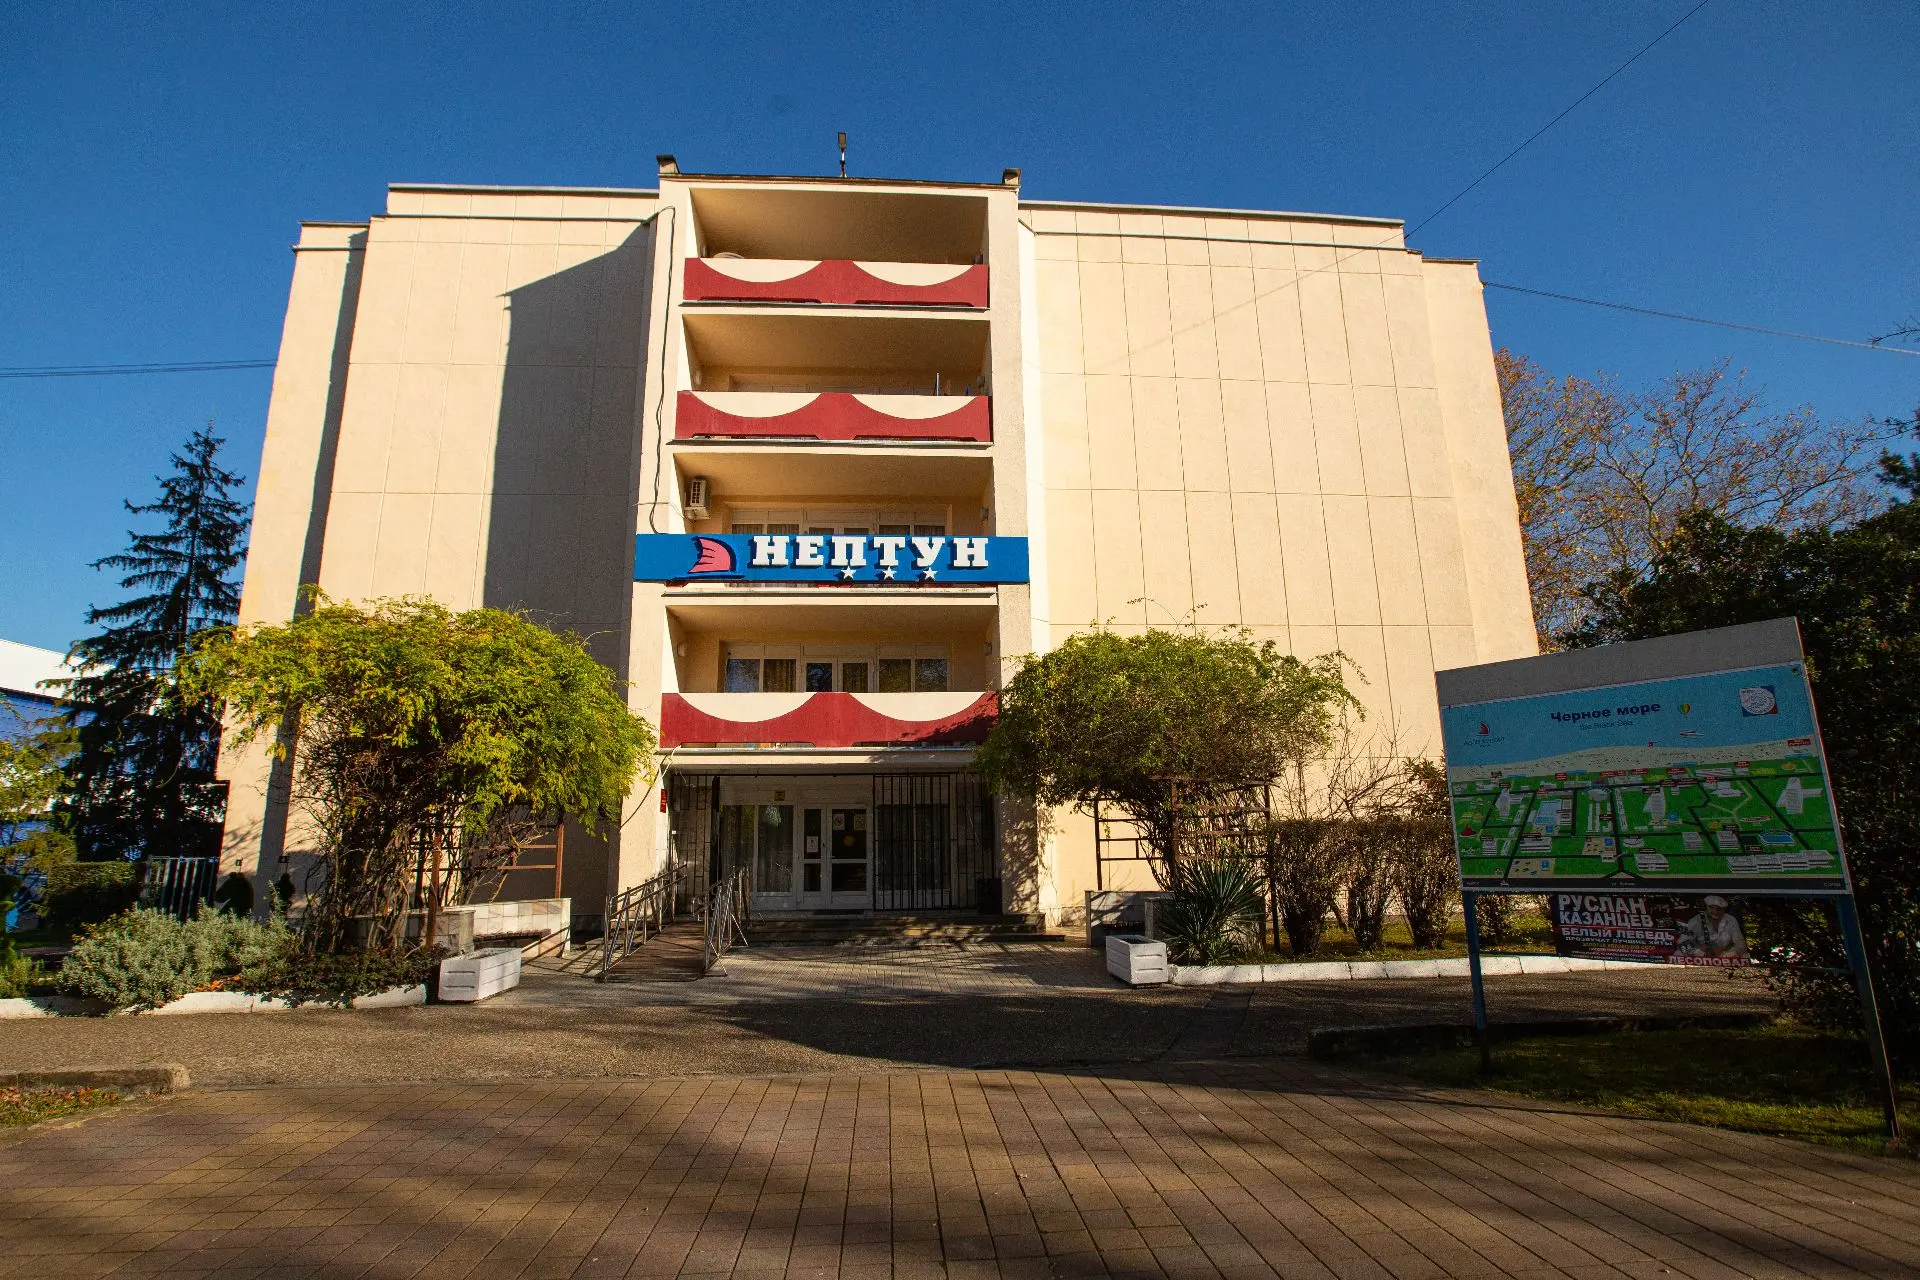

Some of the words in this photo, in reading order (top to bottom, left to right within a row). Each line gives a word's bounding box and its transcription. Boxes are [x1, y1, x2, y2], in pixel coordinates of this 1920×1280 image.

[752, 535, 989, 568] НЕПТУН
[1550, 707, 1612, 724] Черное
[1617, 702, 1661, 716] море
[1557, 894, 1647, 915] РУСЛАН
[1559, 911, 1654, 928] КАЗАНЦЕВ
[1616, 929, 1675, 942] ЛЕБЕДЬ
